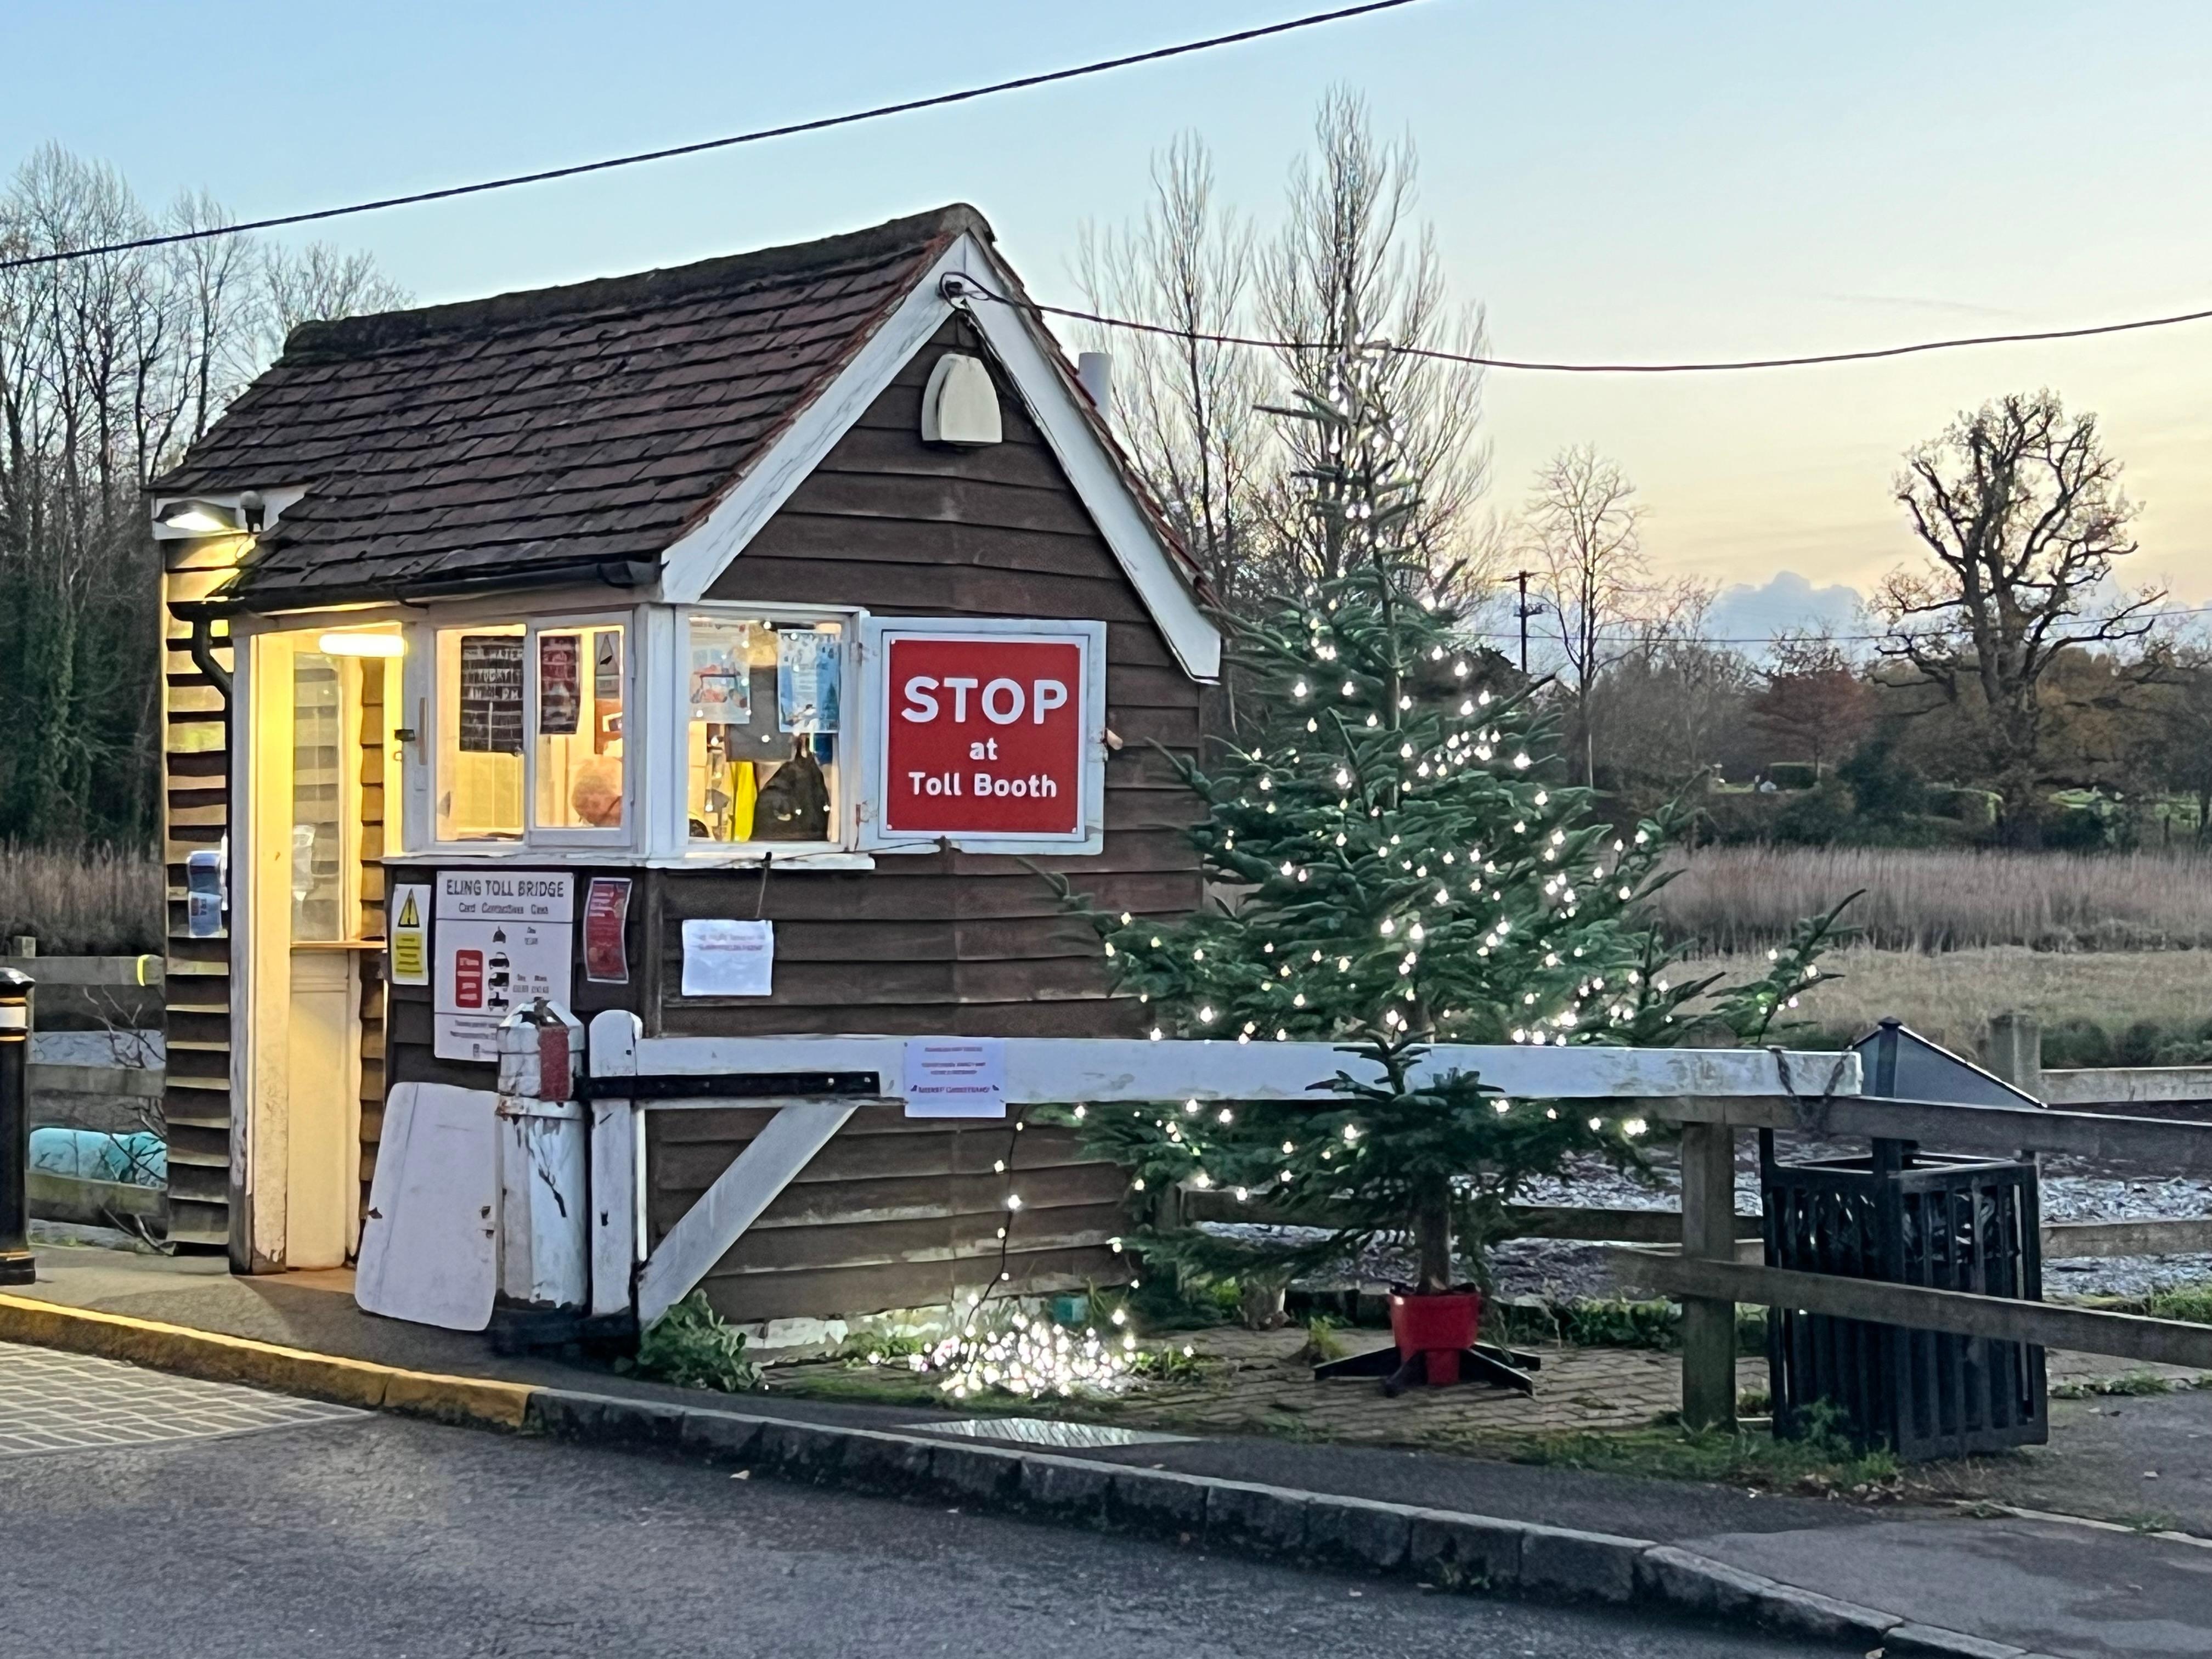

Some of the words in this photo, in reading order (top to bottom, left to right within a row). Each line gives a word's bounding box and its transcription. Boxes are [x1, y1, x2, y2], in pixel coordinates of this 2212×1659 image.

[901, 676, 1068, 725] STOP
[969, 737, 998, 760] at
[908, 771, 962, 796] Toll
[974, 773, 1057, 798] Booth
[447, 879, 481, 895] ELING
[486, 879, 514, 896] TOLL
[518, 880, 564, 898] BRIDGE
